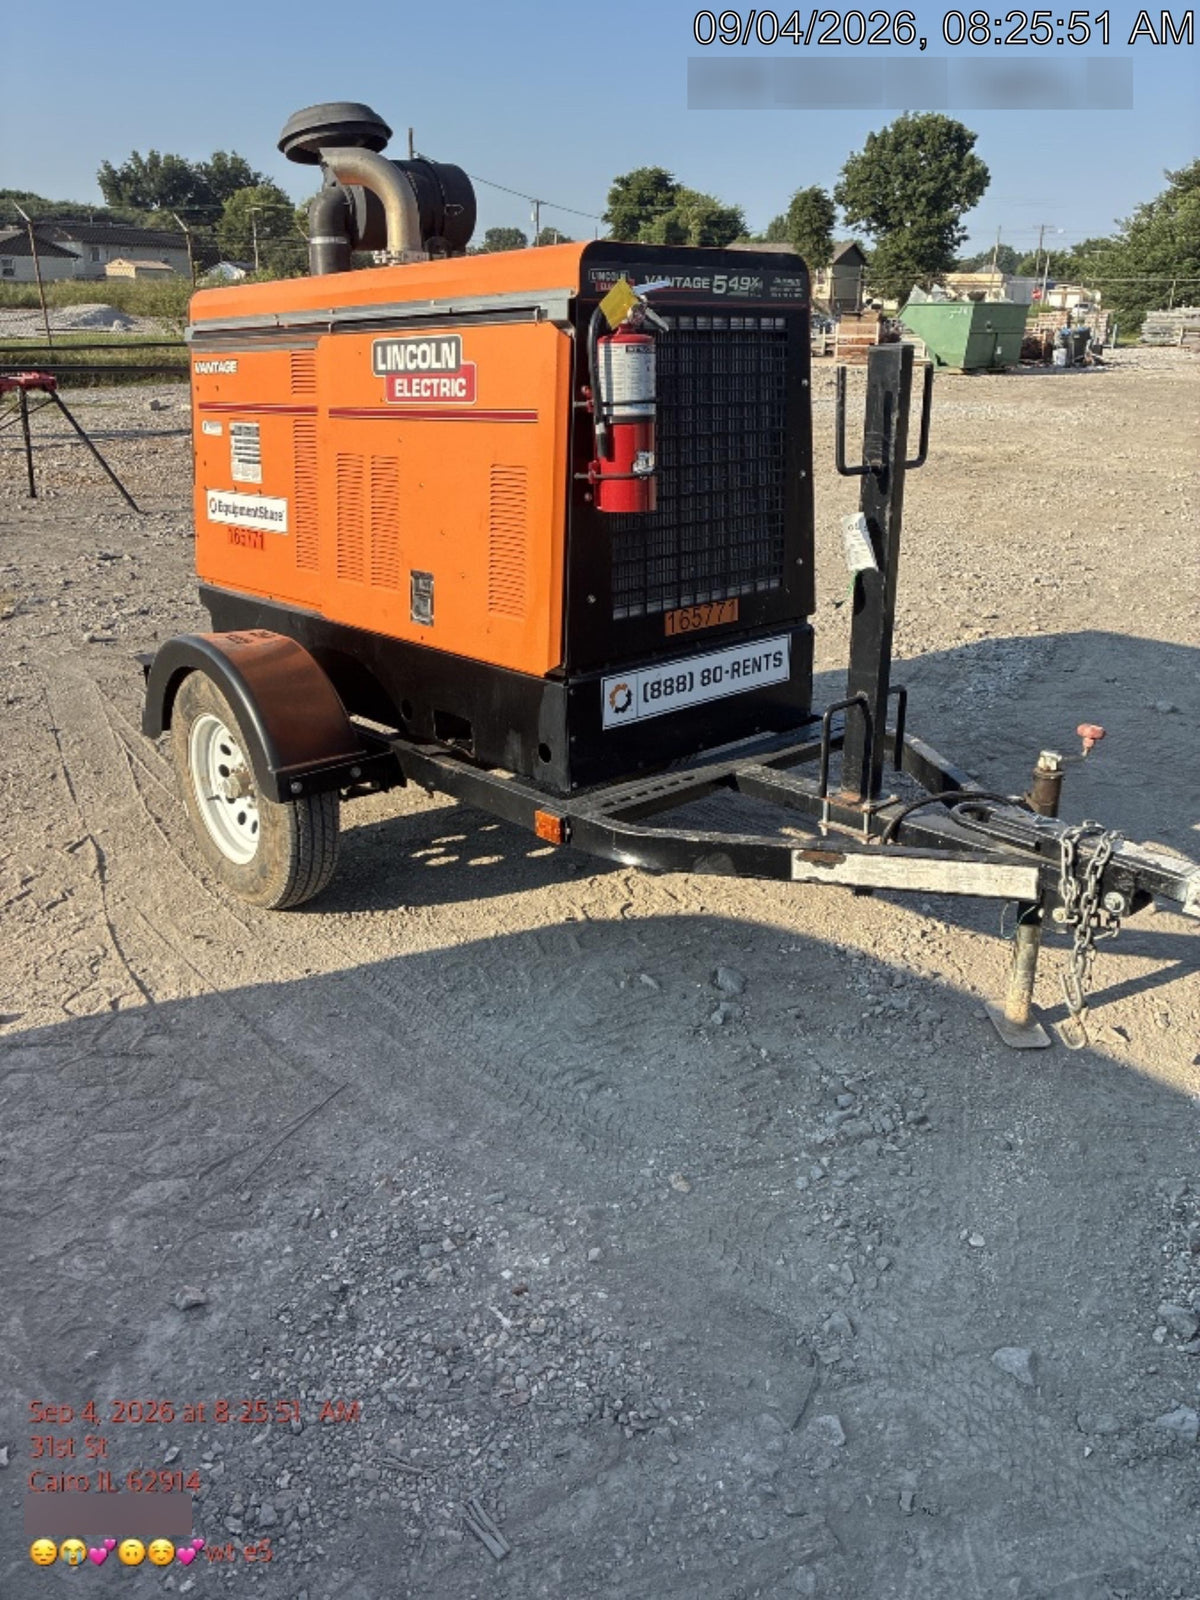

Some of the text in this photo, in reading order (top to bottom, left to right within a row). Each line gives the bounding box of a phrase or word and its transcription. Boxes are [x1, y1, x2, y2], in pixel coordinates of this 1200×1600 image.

[194, 360, 238, 374] VANTAGE
[376, 342, 456, 371] LINCOLN
[394, 377, 467, 398] ELECTRIC
[218, 500, 284, 521] EquipmentShare
[668, 601, 736, 634] 165771
[643, 671, 695, 703] (888)
